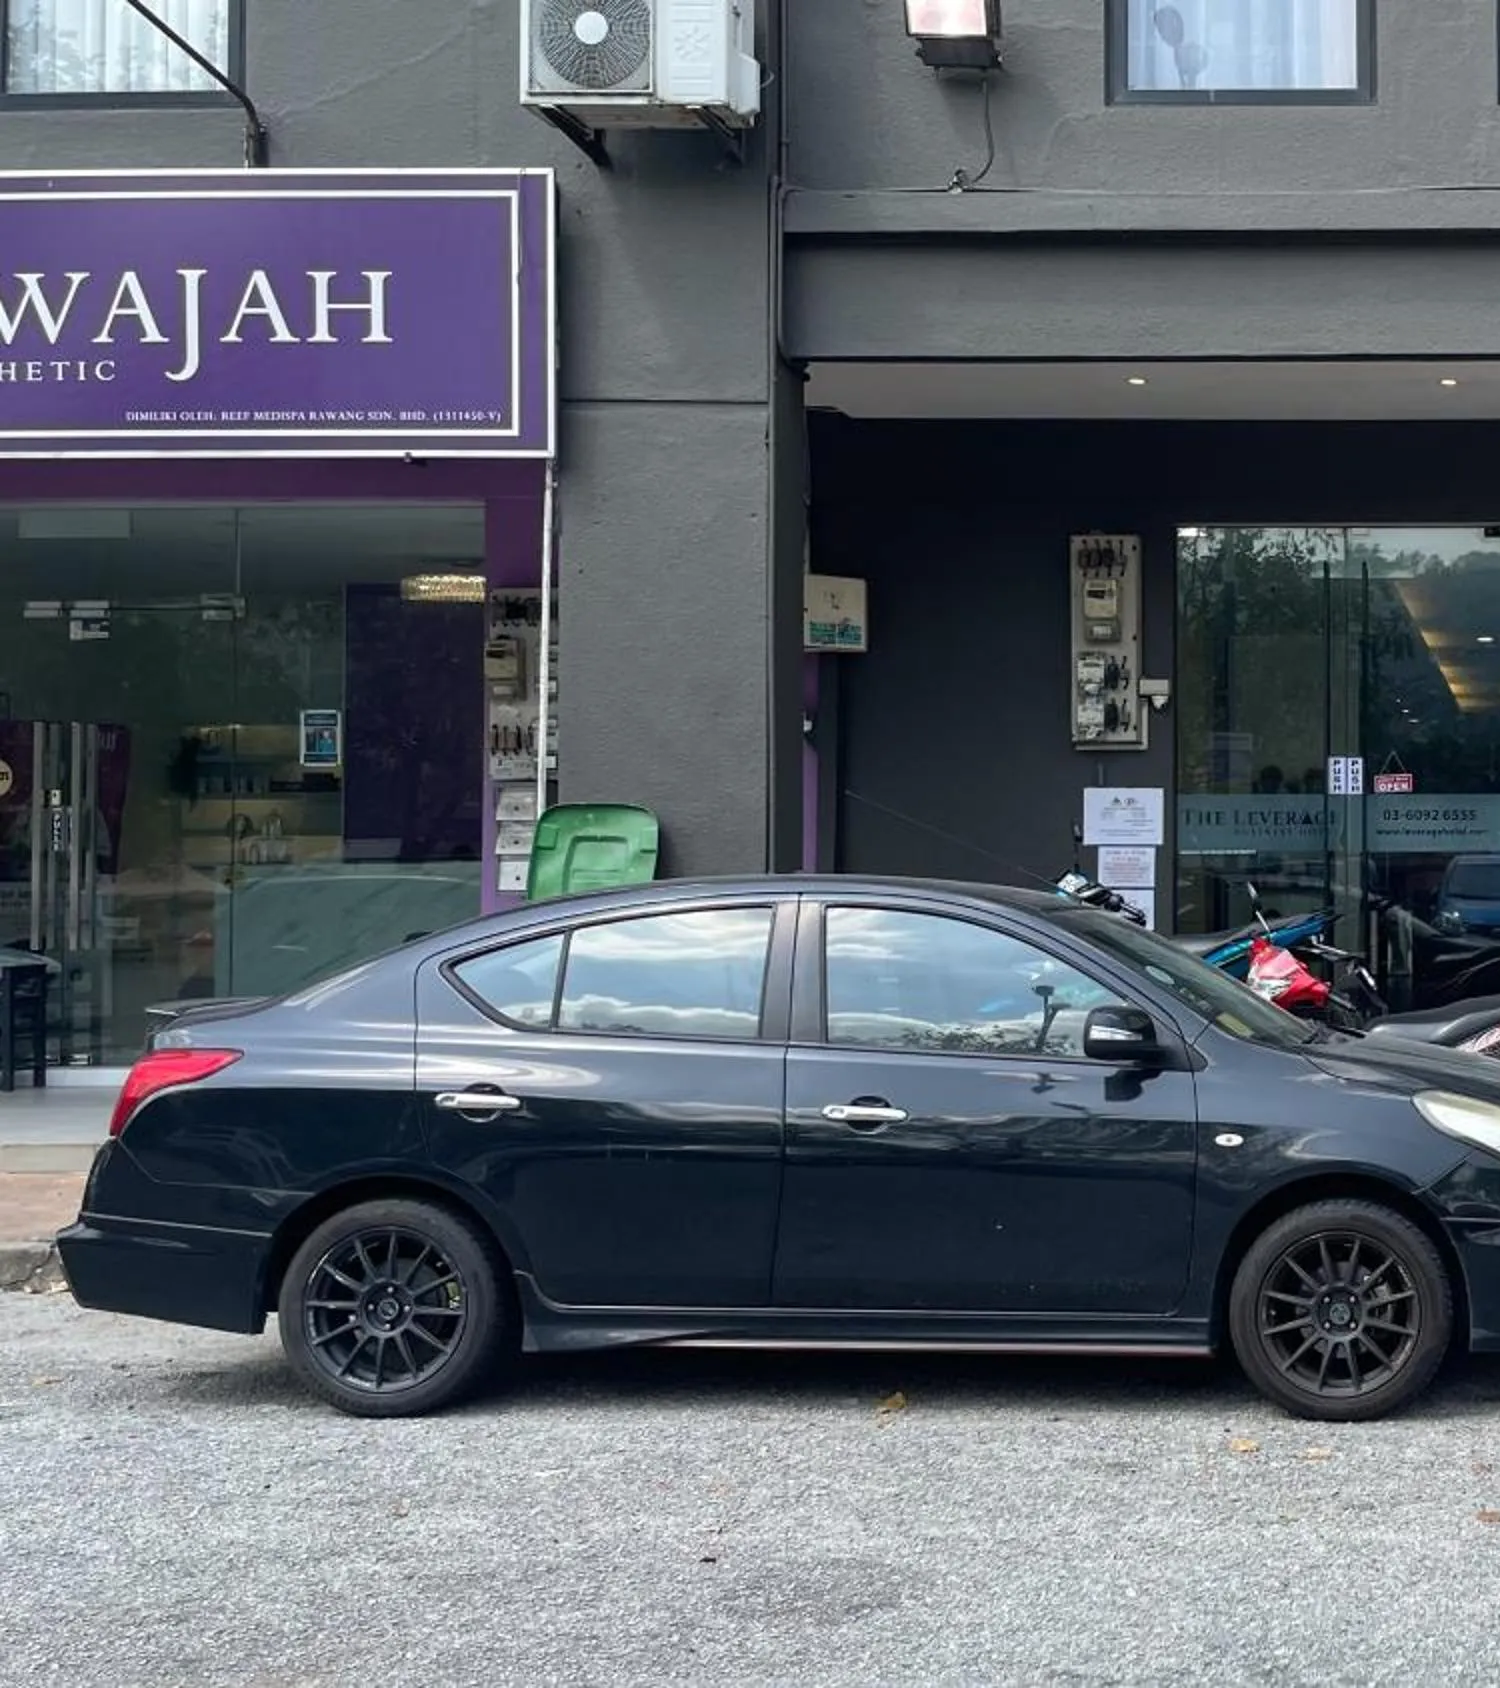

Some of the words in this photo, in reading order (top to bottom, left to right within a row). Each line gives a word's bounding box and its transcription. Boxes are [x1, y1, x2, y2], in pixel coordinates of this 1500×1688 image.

[0, 269, 394, 382] WAJAH
[0, 360, 116, 382] HETIC
[126, 411, 177, 421] DIMILIKI
[179, 411, 216, 421] OLEH:
[221, 411, 250, 421] REEF
[253, 411, 306, 421] MEDISPA
[309, 411, 365, 421] RAWANG
[367, 411, 397, 421] SDN.
[400, 411, 430, 421] BHD.
[1379, 783, 1409, 792] OPEN
[1182, 809, 1226, 826] THE
[1442, 809, 1478, 822] 6555
